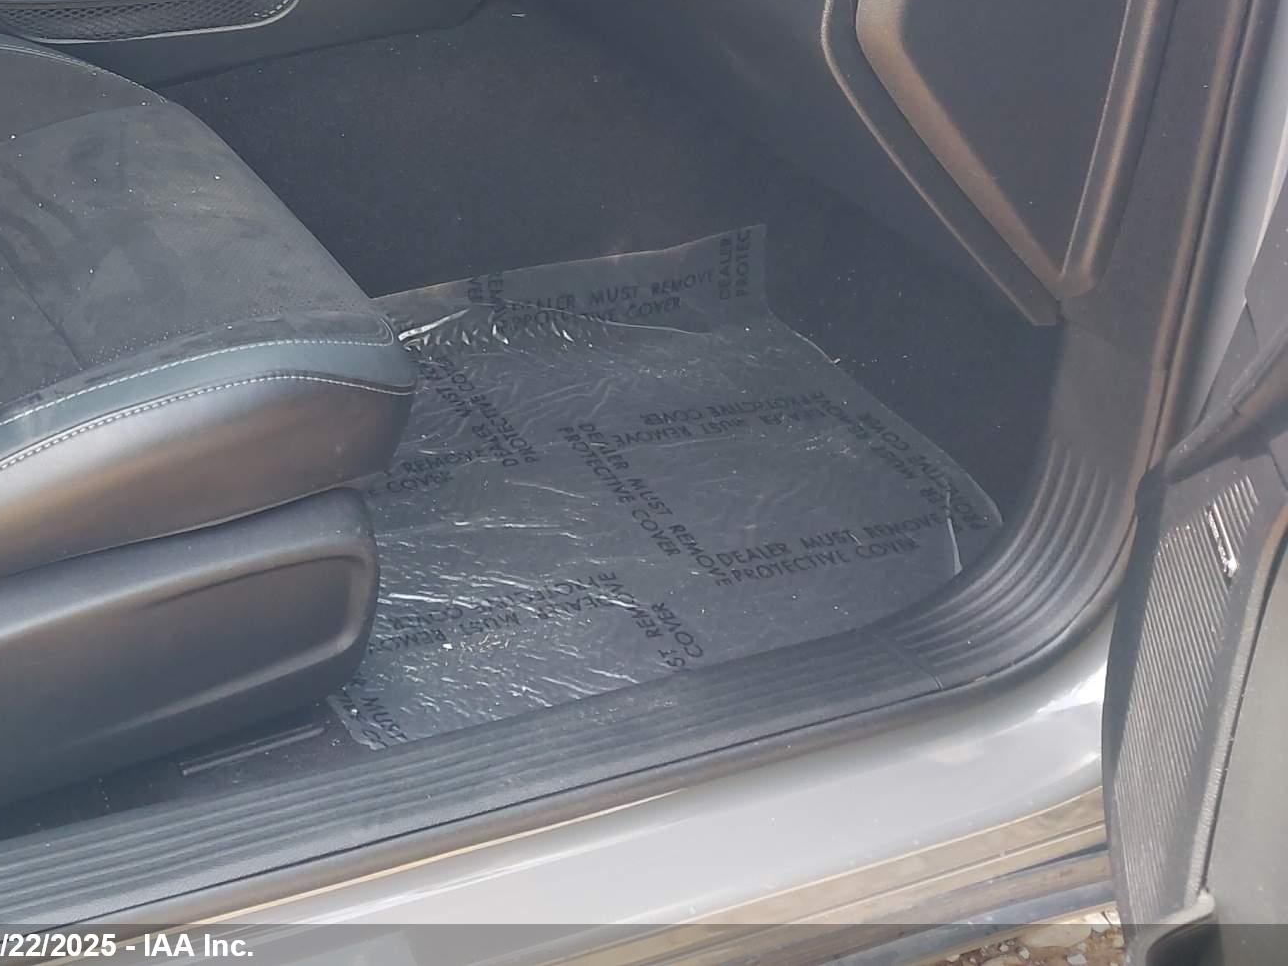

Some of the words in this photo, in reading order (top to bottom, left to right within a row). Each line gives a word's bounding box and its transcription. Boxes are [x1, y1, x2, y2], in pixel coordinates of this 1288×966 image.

[592, 284, 639, 306] MUST
[627, 296, 681, 317] COVER
[612, 425, 692, 446] REMOVE
[640, 409, 703, 425] COVER
[557, 426, 637, 505] PROTECTIVE
[632, 509, 681, 557] COVER
[627, 478, 674, 515] MUST
[668, 524, 732, 586] REMOVE
[716, 542, 787, 568] DEALER
[799, 529, 854, 550] MUST
[863, 513, 948, 539] REMOVE
[732, 550, 851, 583] PROTECTIVE
[856, 537, 920, 559] COVER
[652, 602, 704, 657] COVER
